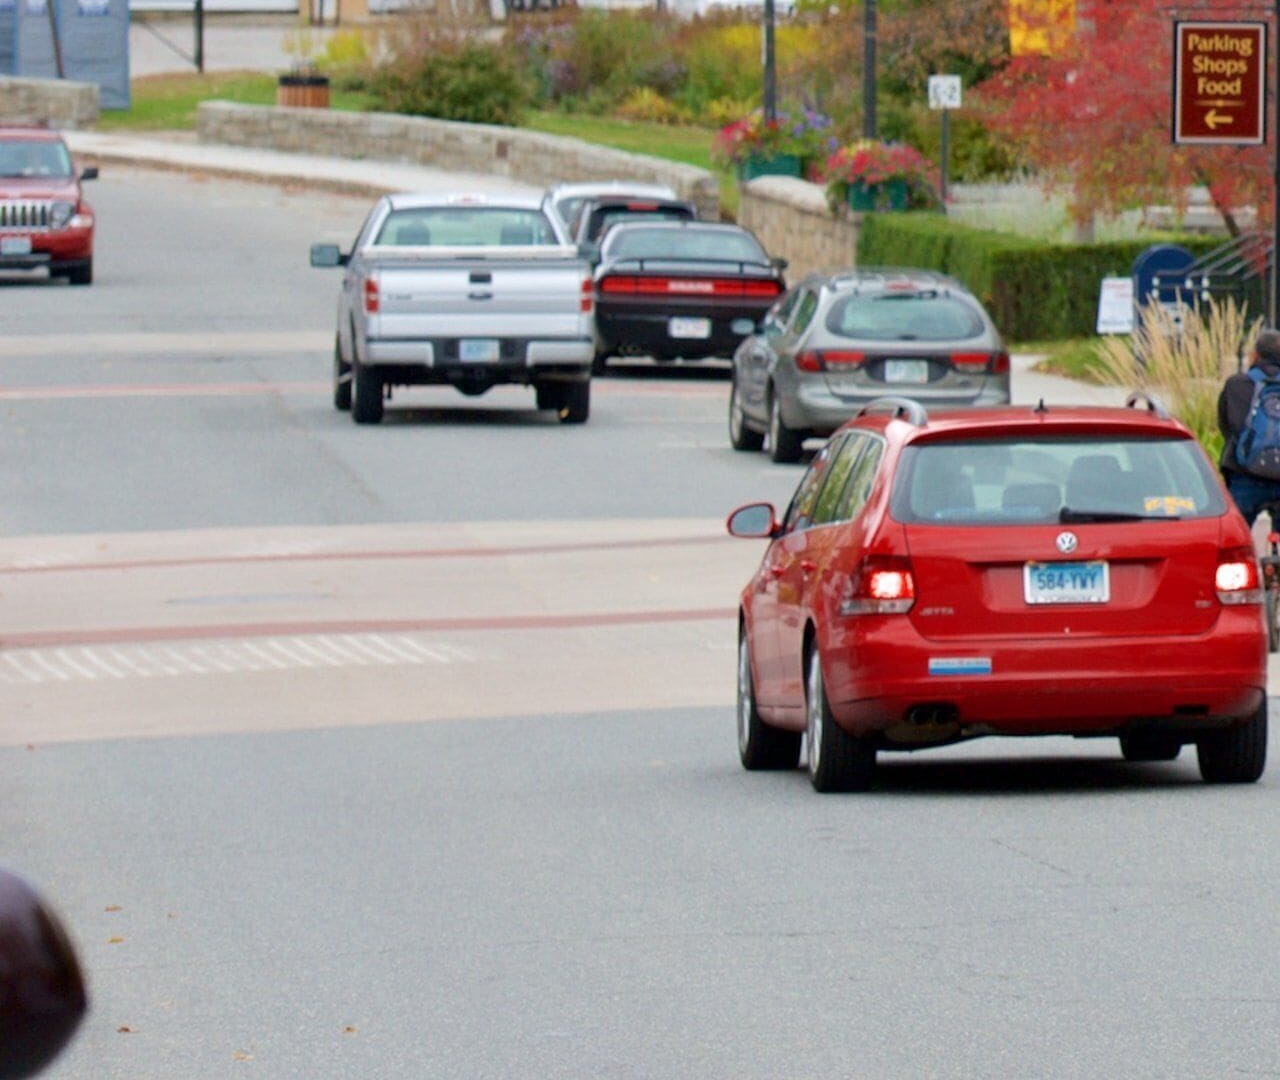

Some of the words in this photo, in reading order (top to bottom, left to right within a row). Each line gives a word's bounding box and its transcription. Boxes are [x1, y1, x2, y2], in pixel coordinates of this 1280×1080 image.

[1188, 33, 1253, 57] Parking
[1192, 55, 1248, 77] Shops
[1197, 77, 1242, 95] Food
